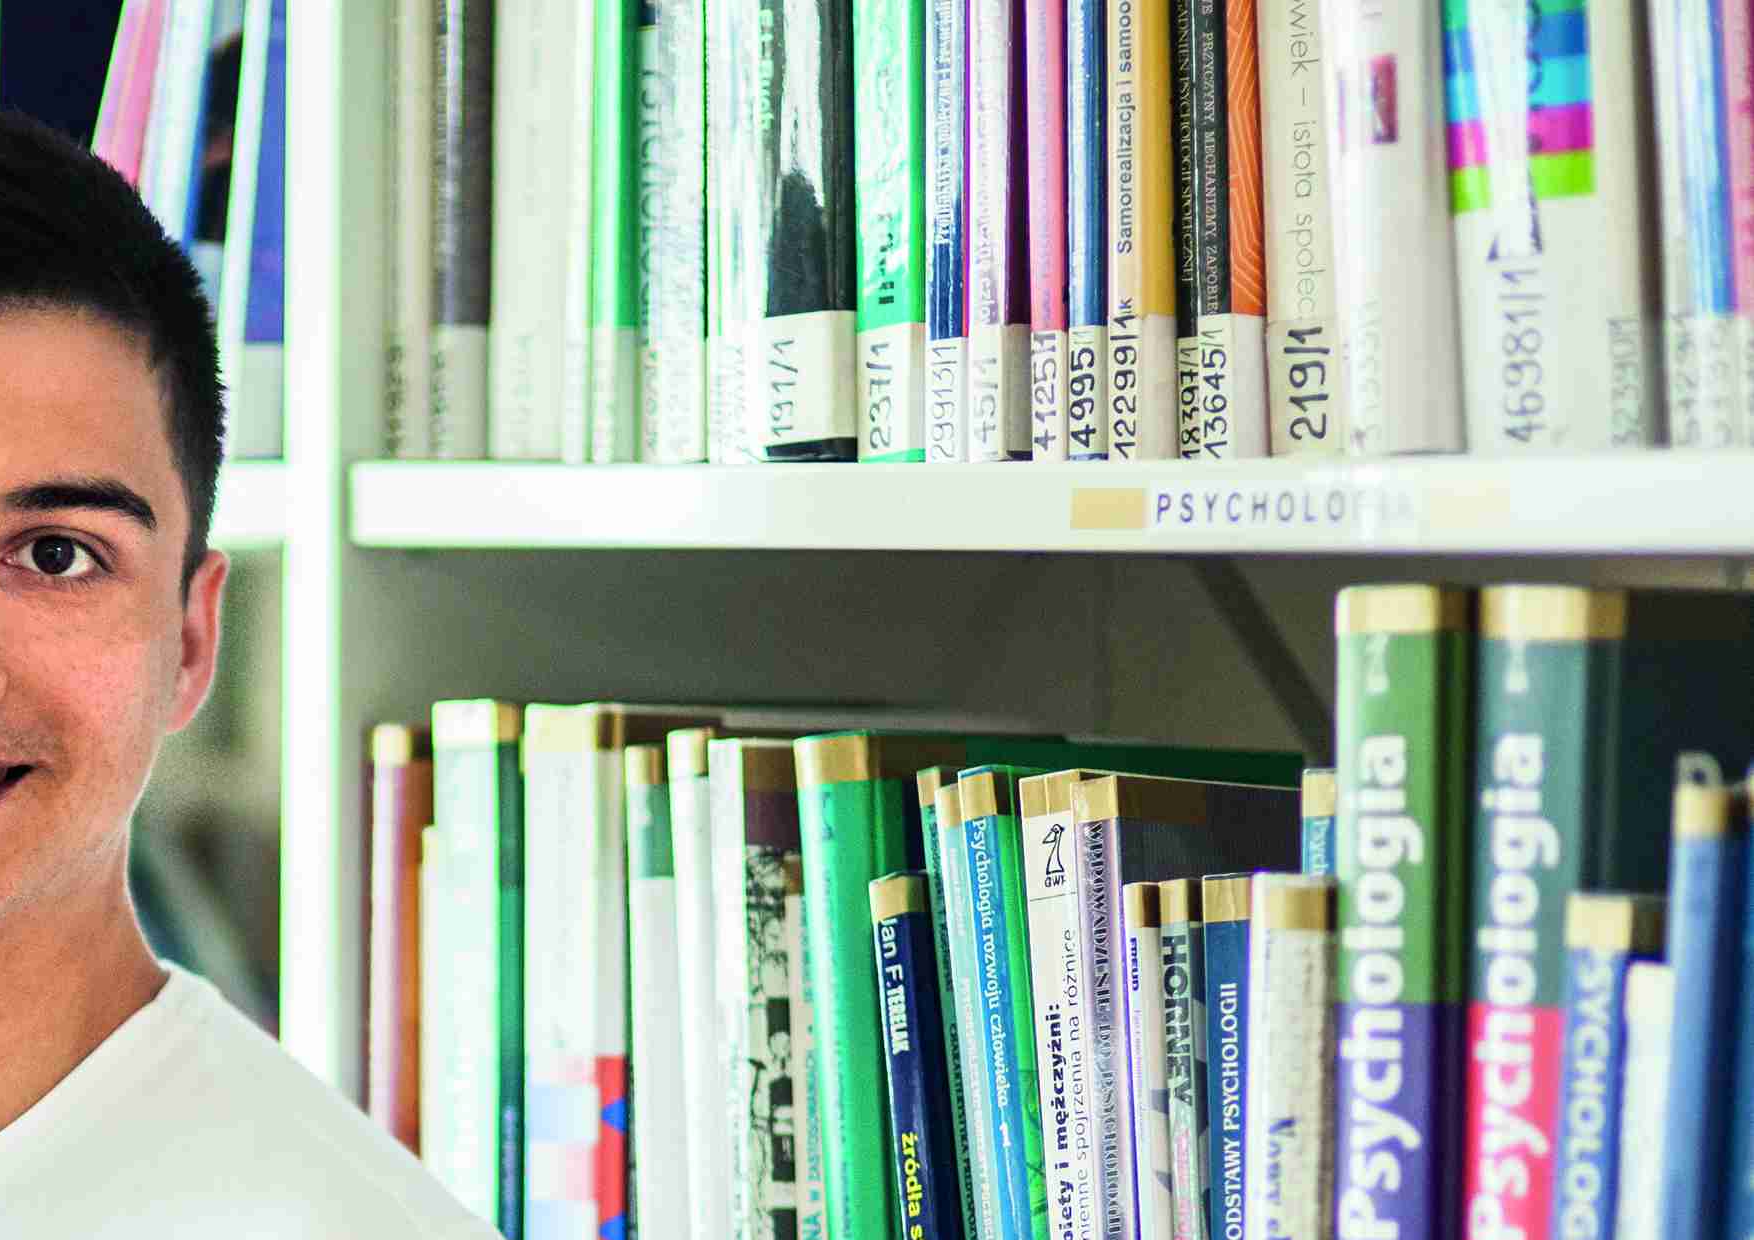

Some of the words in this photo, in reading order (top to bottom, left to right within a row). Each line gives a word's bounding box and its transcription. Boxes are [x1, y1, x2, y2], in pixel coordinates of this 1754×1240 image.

[1116, 91, 1138, 255] Samorealizacja
[1292, 120, 1318, 199] istota
[970, 817, 996, 929] Psychologia
[981, 932, 1003, 1009] rozwoju
[1061, 928, 1079, 1007] różnice
[1160, 935, 1193, 1106] HORNEY
[1045, 1003, 1071, 1151] mężczyźni:
[1067, 1015, 1081, 1042] na
[1219, 981, 1241, 1131] PSYCHOLOGII
[1069, 1050, 1090, 1161] spojrzenia
[900, 1131, 923, 1217] źródła
